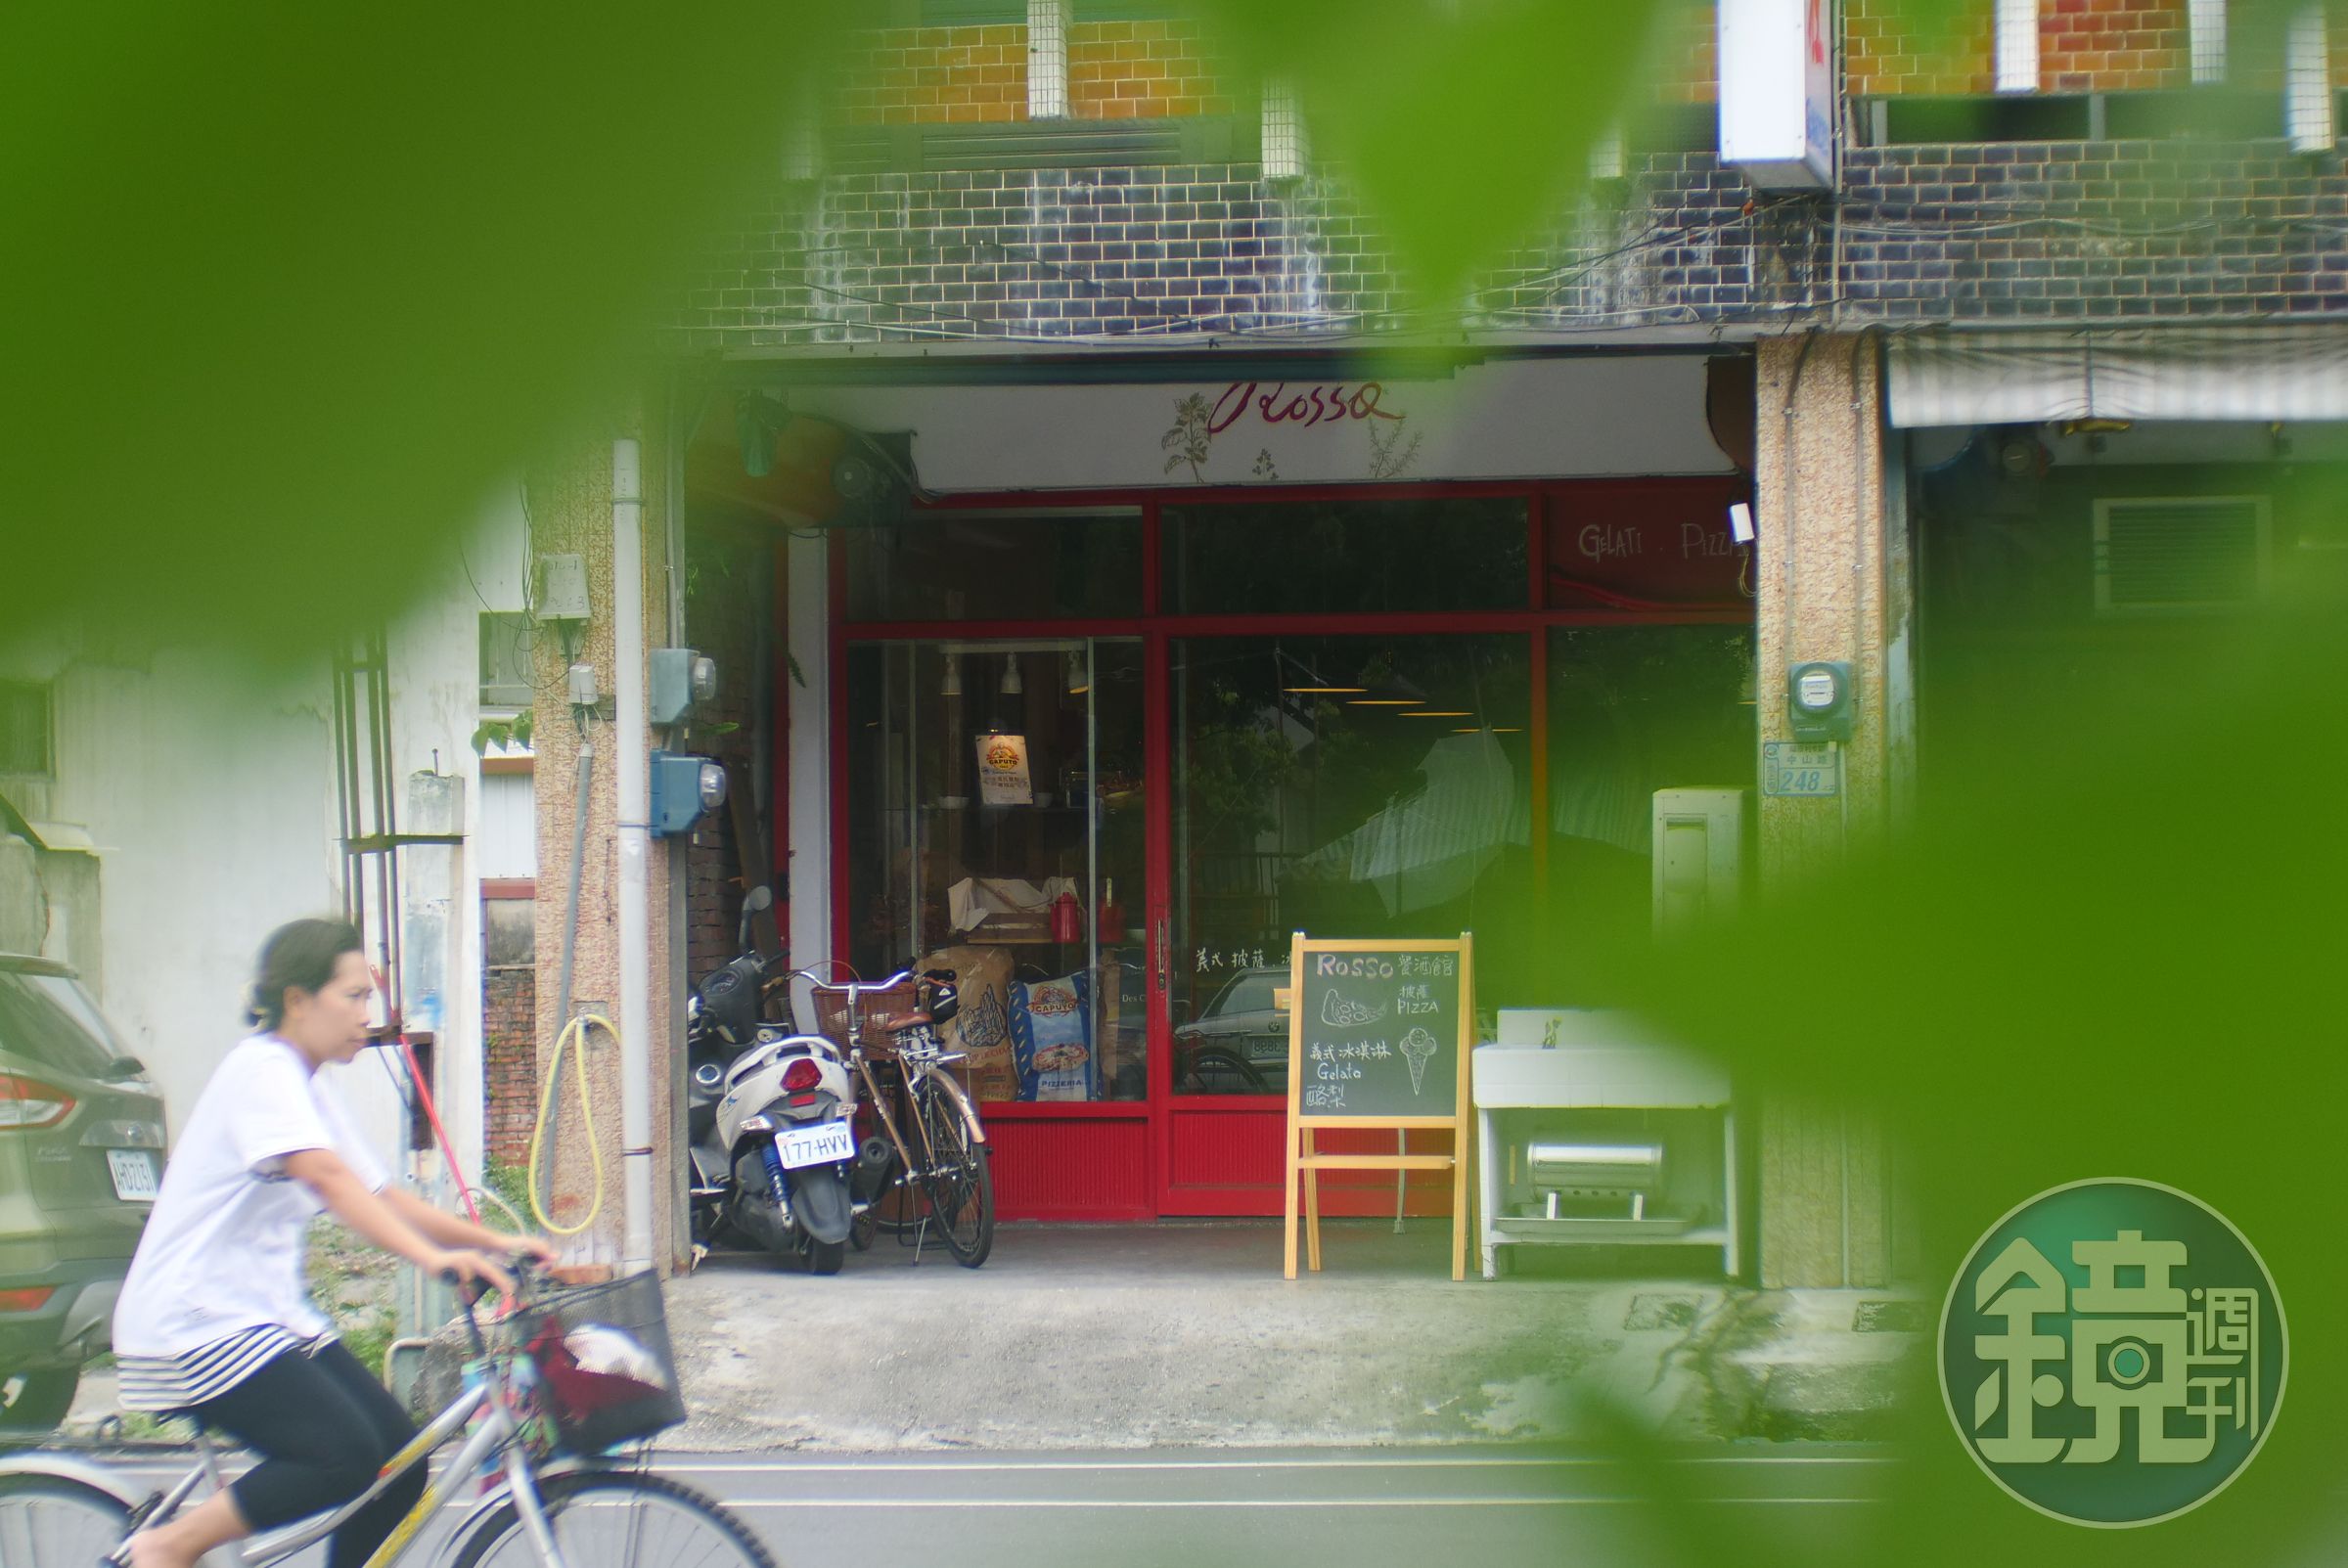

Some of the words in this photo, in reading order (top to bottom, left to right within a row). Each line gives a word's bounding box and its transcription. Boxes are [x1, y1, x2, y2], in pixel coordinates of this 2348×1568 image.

[1780, 771, 1821, 791] 248
[1398, 955, 1453, 976] 餐酒館
[1399, 984, 1430, 1000] 披薩
[1037, 1002, 1075, 1011] CAPUTO
[1397, 999, 1439, 1014] PIZZA
[1317, 1062, 1362, 1080] Gelato
